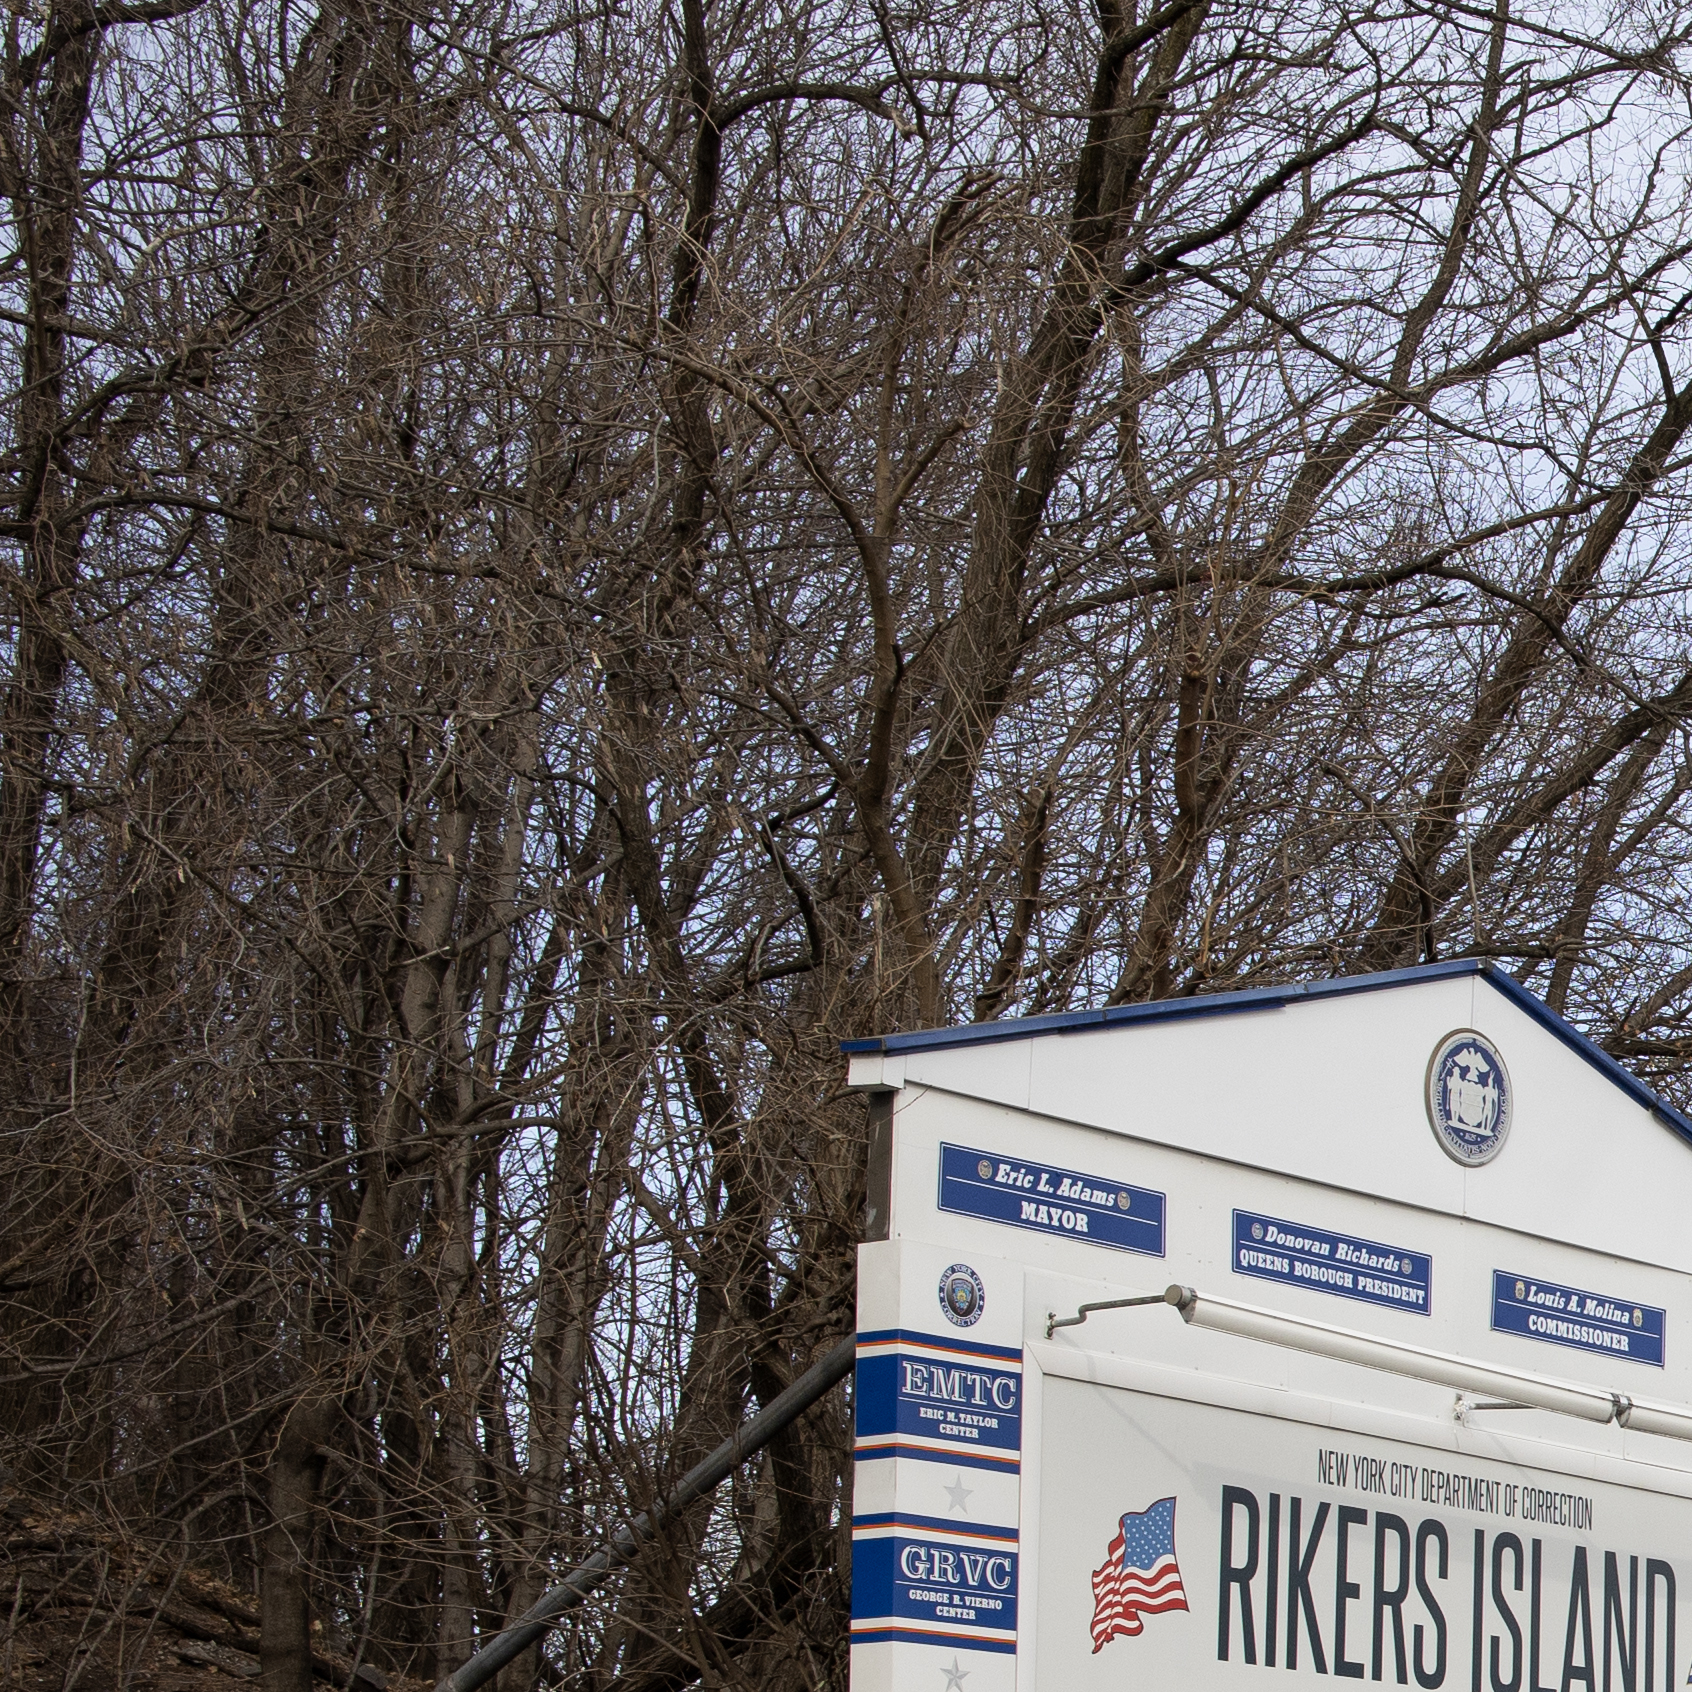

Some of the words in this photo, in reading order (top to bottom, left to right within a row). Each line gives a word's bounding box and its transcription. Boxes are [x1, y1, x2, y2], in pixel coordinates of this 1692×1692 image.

[994, 1163, 1034, 1189] Eric
[1036, 1174, 1054, 1194] L.
[1056, 1176, 1116, 1208] Adams
[1020, 1200, 1089, 1233] MAYOR
[1264, 1225, 1330, 1257] Donovan
[1335, 1241, 1400, 1273] Richards
[940, 1267, 953, 1289] NEW
[953, 1264, 971, 1276] YORK
[971, 1271, 984, 1297] CITY
[1240, 1248, 1289, 1274] QUEENS
[1293, 1261, 1354, 1289] BOROUGH
[1357, 1276, 1425, 1305] PRESIDENT
[941, 1302, 982, 1327] CORRECTION
[1527, 1285, 1565, 1312] Louis
[1566, 1297, 1581, 1314] A.
[1583, 1301, 1631, 1324] Molina
[1528, 1314, 1630, 1352] COMMISSIONER
[901, 1360, 1017, 1409] EMTC
[919, 1407, 944, 1420] ERIC
[947, 1411, 958, 1423] M.
[958, 1412, 999, 1429] TAYLOR
[939, 1423, 979, 1439] CENTER
[1318, 1449, 1349, 1487] NEW
[1353, 1454, 1387, 1494] YORK
[1390, 1462, 1418, 1500] CITY
[1421, 1467, 1501, 1515] DEPARTMENT
[1504, 1481, 1519, 1518] OF
[1521, 1486, 1592, 1531] CORRECTION
[900, 1544, 1012, 1590] GRVC
[908, 1589, 950, 1604] GEORGE
[964, 1595, 1003, 1610] VIERNO
[1218, 1484, 1449, 1690] RIKERS
[936, 1605, 976, 1620] CENTER
